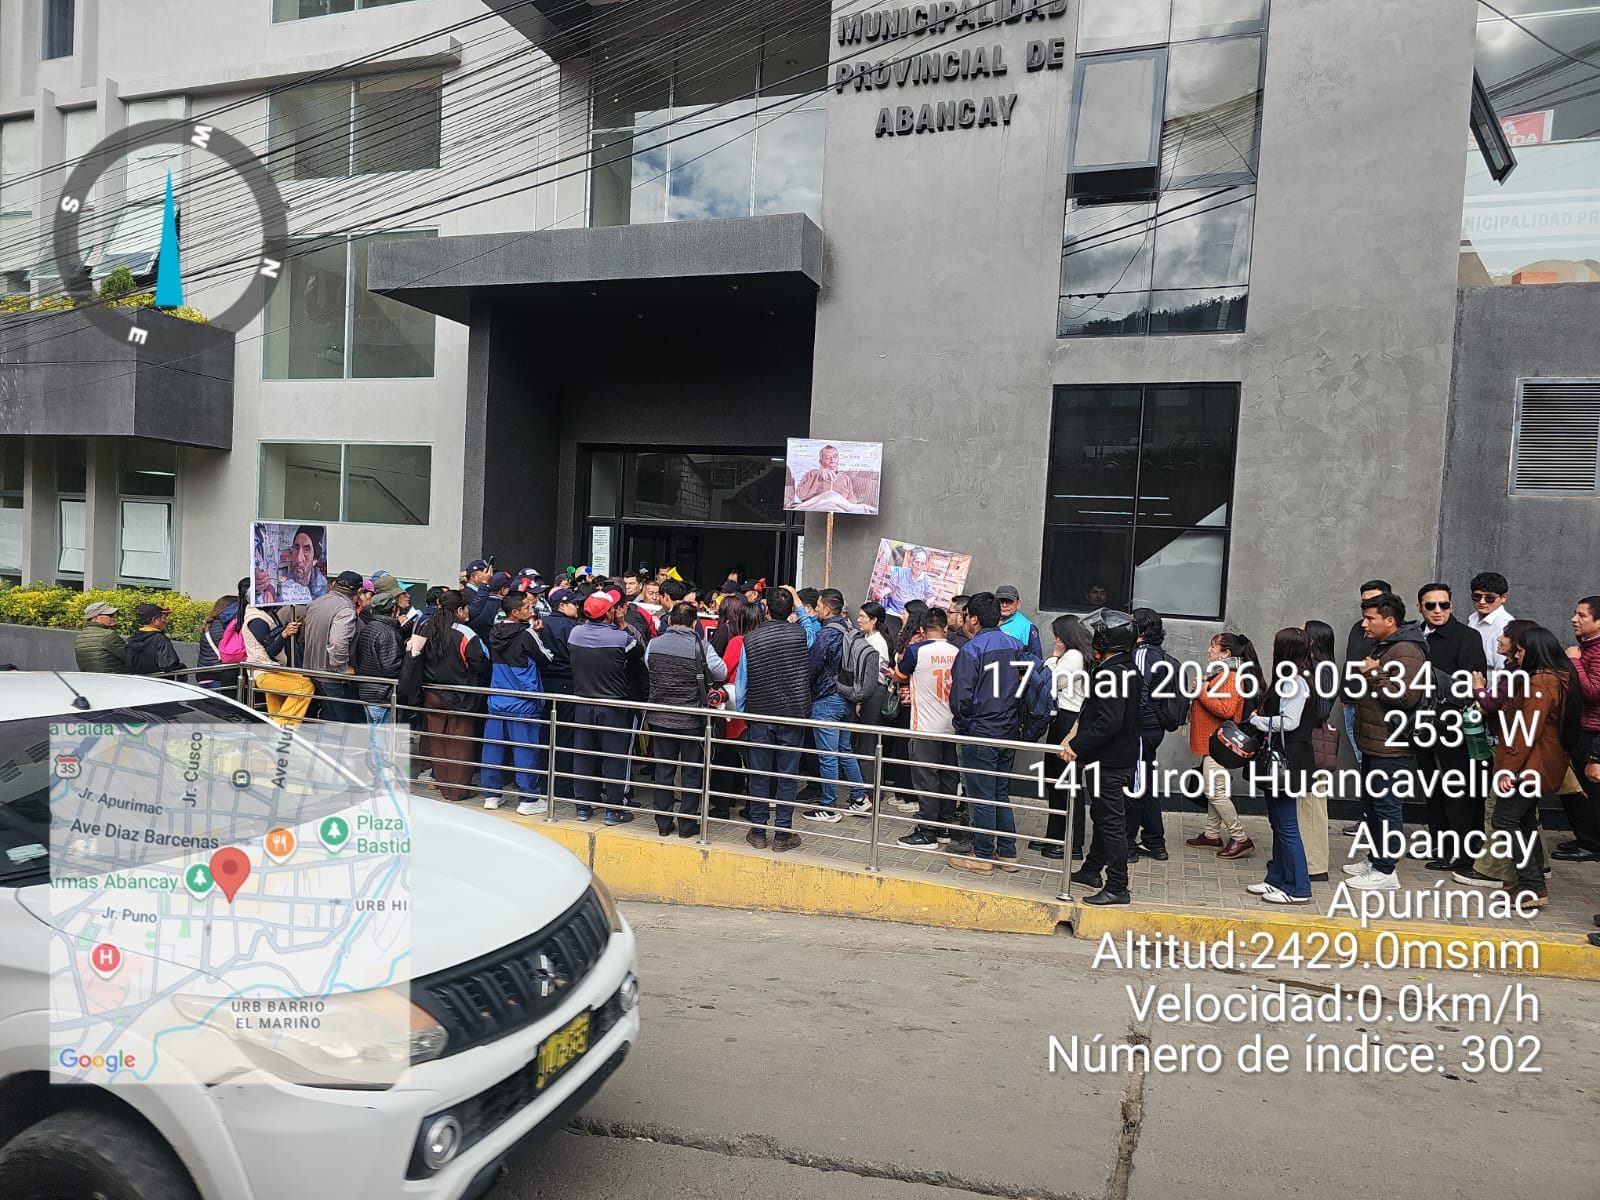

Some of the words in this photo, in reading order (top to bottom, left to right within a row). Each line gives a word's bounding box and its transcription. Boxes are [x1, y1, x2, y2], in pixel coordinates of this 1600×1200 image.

[838, 0, 1067, 45] MUNICIPALIDAD
[835, 44, 1008, 93] PROVINCIAL
[1025, 37, 1065, 72] DE
[875, 94, 1017, 138] ABANCAY
